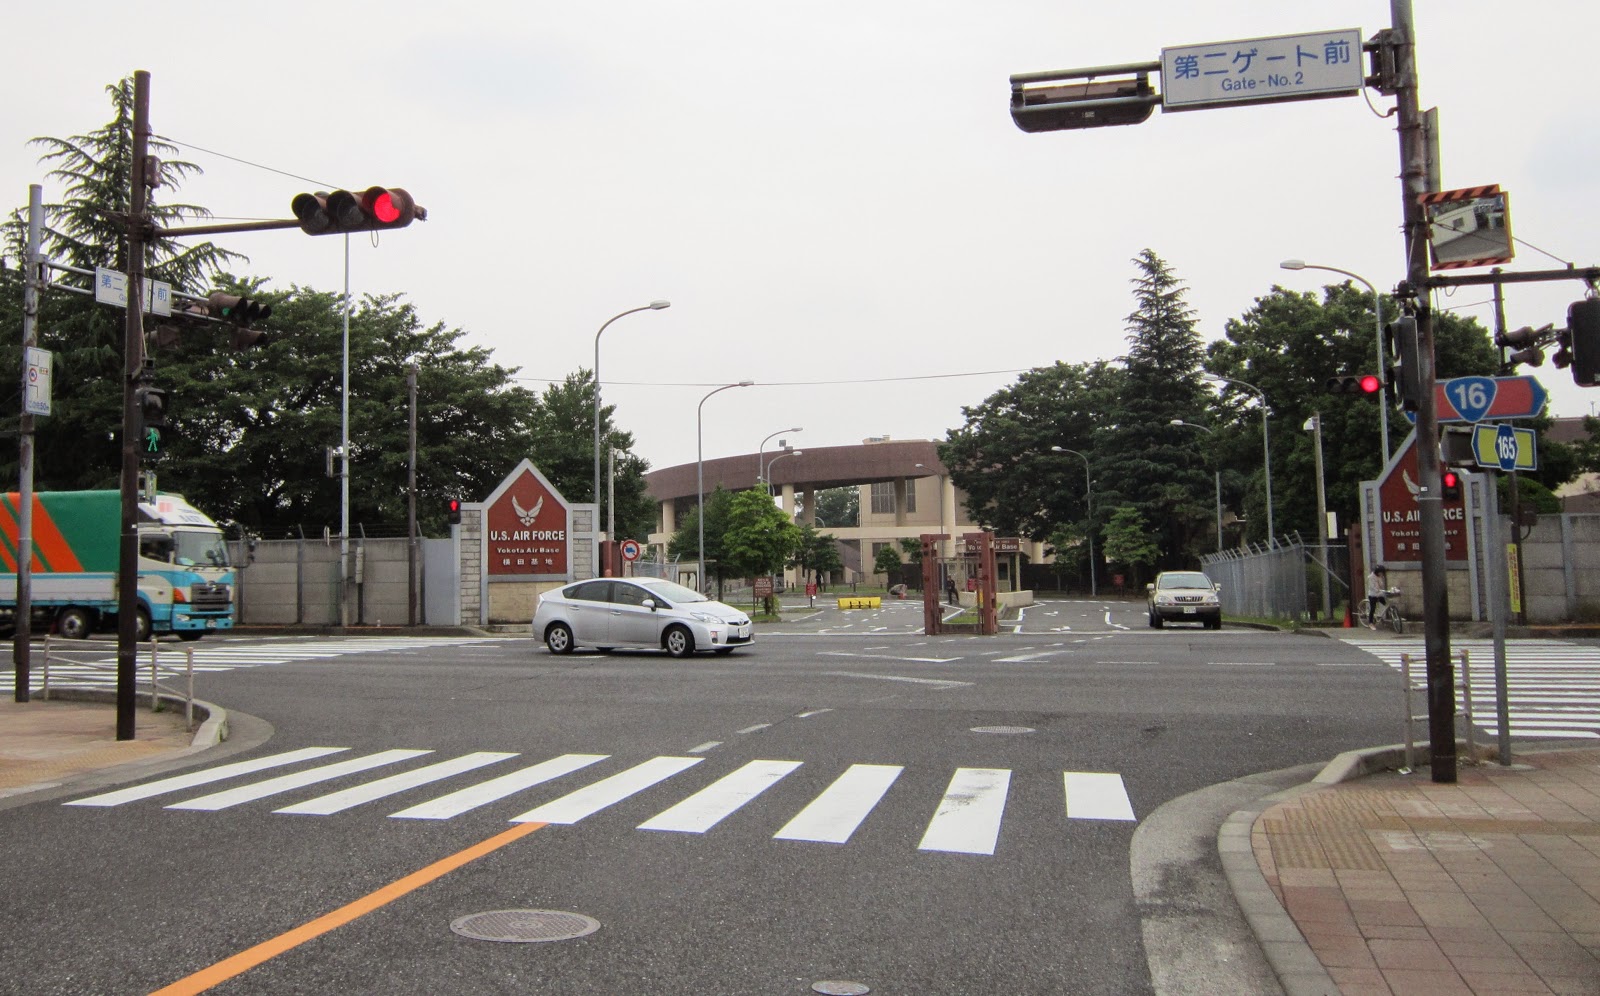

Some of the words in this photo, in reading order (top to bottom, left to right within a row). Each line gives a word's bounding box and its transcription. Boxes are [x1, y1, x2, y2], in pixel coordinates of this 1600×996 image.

[1174, 40, 1350, 79] 第二ゲート前
[1455, 382, 1487, 410] 16
[1498, 435, 1516, 460] 165
[1383, 510, 1404, 523] U.S.
[490, 530, 511, 541] U.S.
[513, 530, 530, 541] AIR
[532, 530, 565, 541] FORCE
